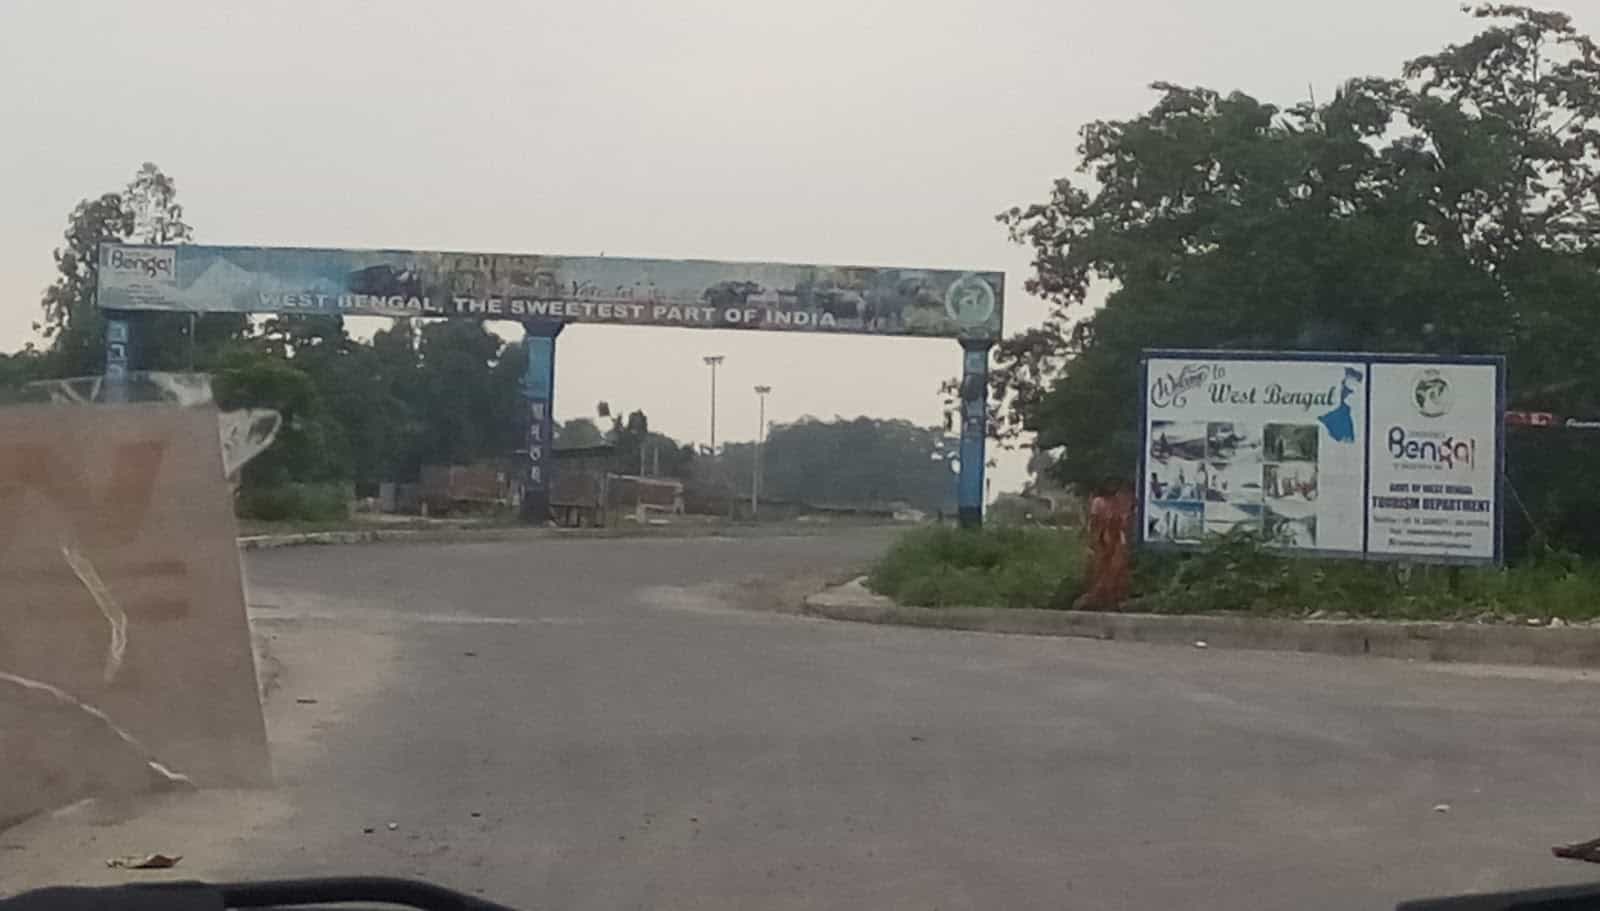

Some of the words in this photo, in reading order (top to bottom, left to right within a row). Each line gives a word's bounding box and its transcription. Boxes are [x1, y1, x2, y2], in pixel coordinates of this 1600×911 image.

[111, 249, 173, 279] Bengal
[259, 292, 328, 307] WEST
[453, 298, 502, 314] THE
[511, 299, 645, 319] SWEETEST
[654, 305, 716, 322] PART
[724, 310, 758, 323] OF
[766, 310, 837, 327] INDIA
[1212, 364, 1226, 379] to
[1208, 382, 1257, 404] West
[1264, 382, 1337, 412] Bengal
[1388, 426, 1476, 471] Bengal
[1372, 496, 1420, 510] TOURISM
[1422, 498, 1491, 513] DEPARTMENT
